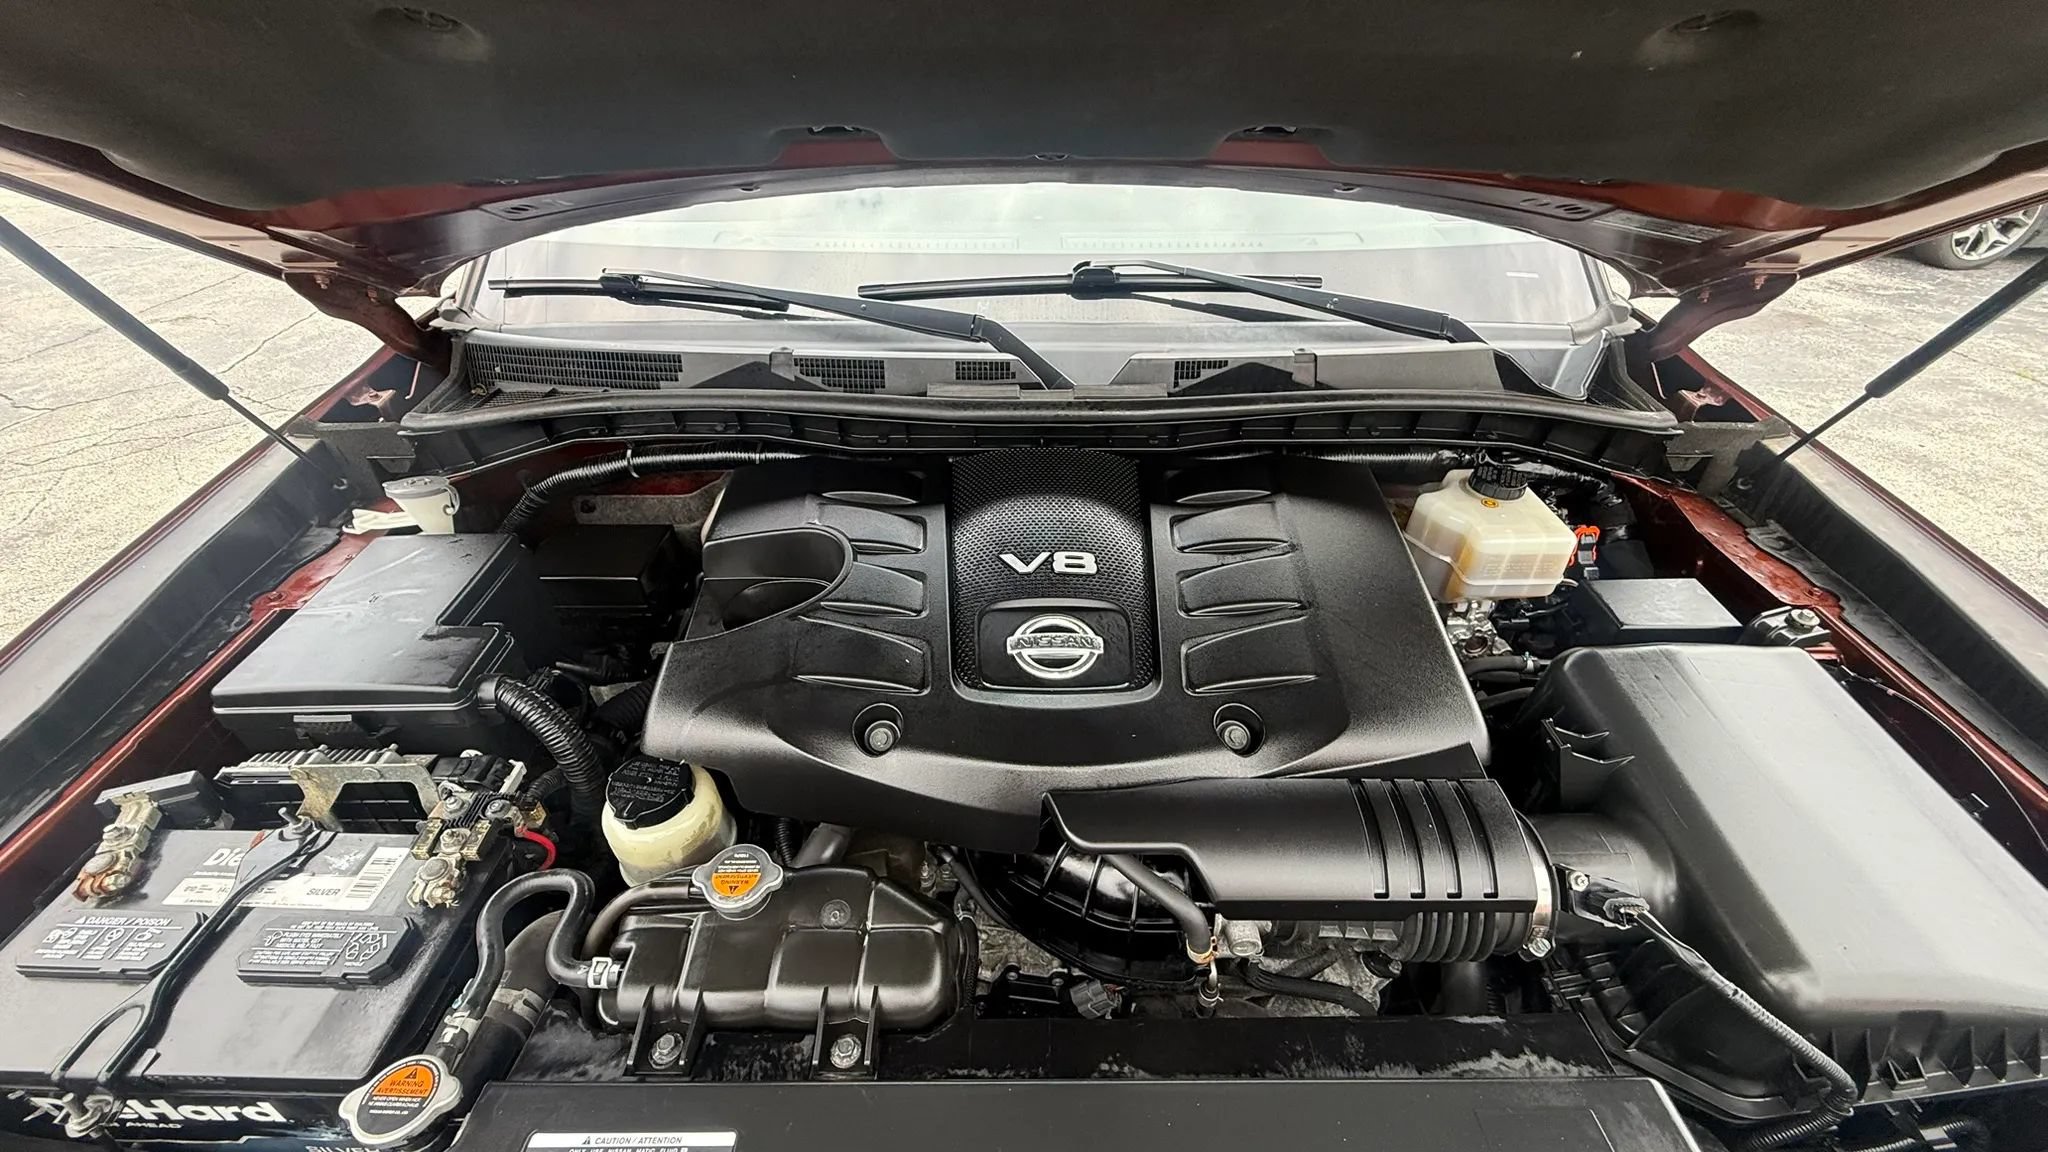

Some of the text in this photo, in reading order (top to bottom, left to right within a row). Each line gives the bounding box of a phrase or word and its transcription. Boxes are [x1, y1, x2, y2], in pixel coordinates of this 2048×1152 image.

[999, 551, 1098, 575] V8
[1016, 635, 1095, 649] NISSAN
[306, 888, 341, 896] SILVER
[87, 917, 126, 925] DANGER
[133, 918, 172, 926] POISON
[389, 1080, 424, 1088] WARNING
[377, 1087, 428, 1095] AVERTISSEMENT
[594, 1137, 631, 1145] CAUTION
[637, 1137, 683, 1145] ATTENTION
